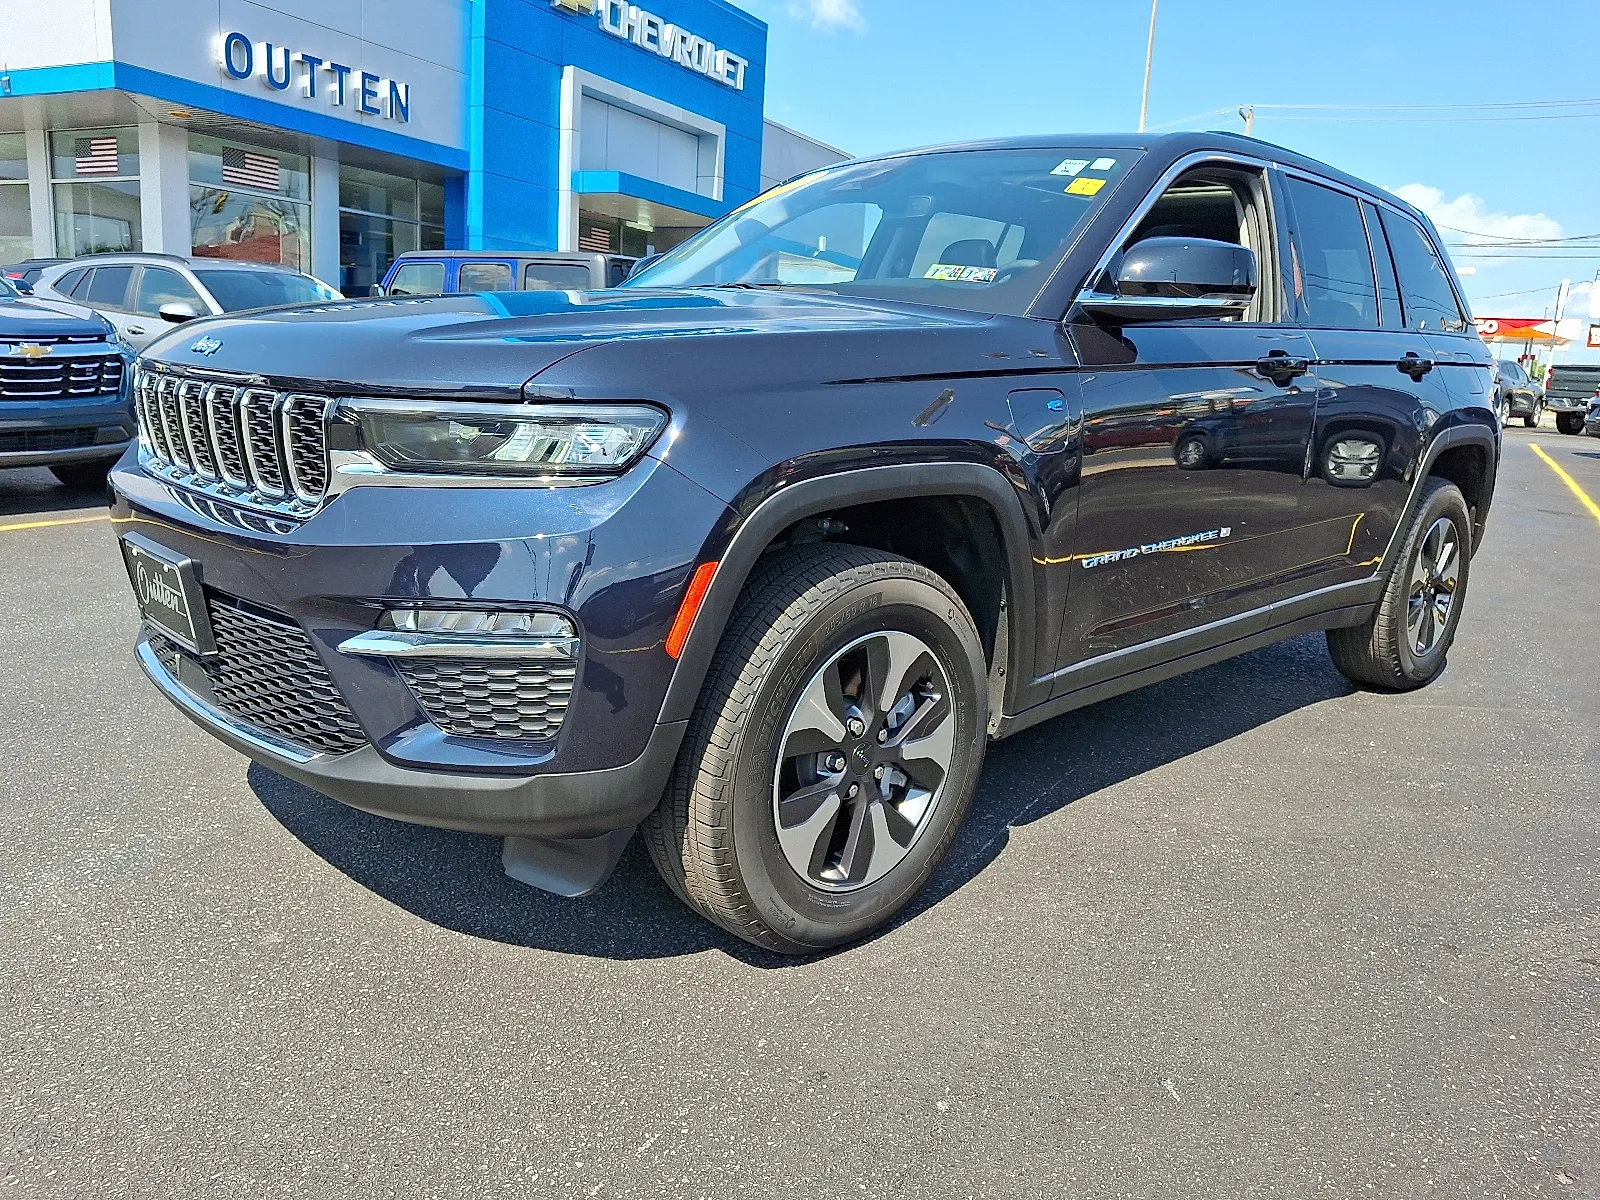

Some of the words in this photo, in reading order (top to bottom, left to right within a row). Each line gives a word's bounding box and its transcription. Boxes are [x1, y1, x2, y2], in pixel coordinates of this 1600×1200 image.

[221, 31, 410, 123] OUTTEN
[599, 0, 748, 90] CHEVROLET
[1082, 548, 1138, 569] GRAND
[1140, 530, 1219, 555] CHEROKEE
[136, 561, 187, 617] Outten
